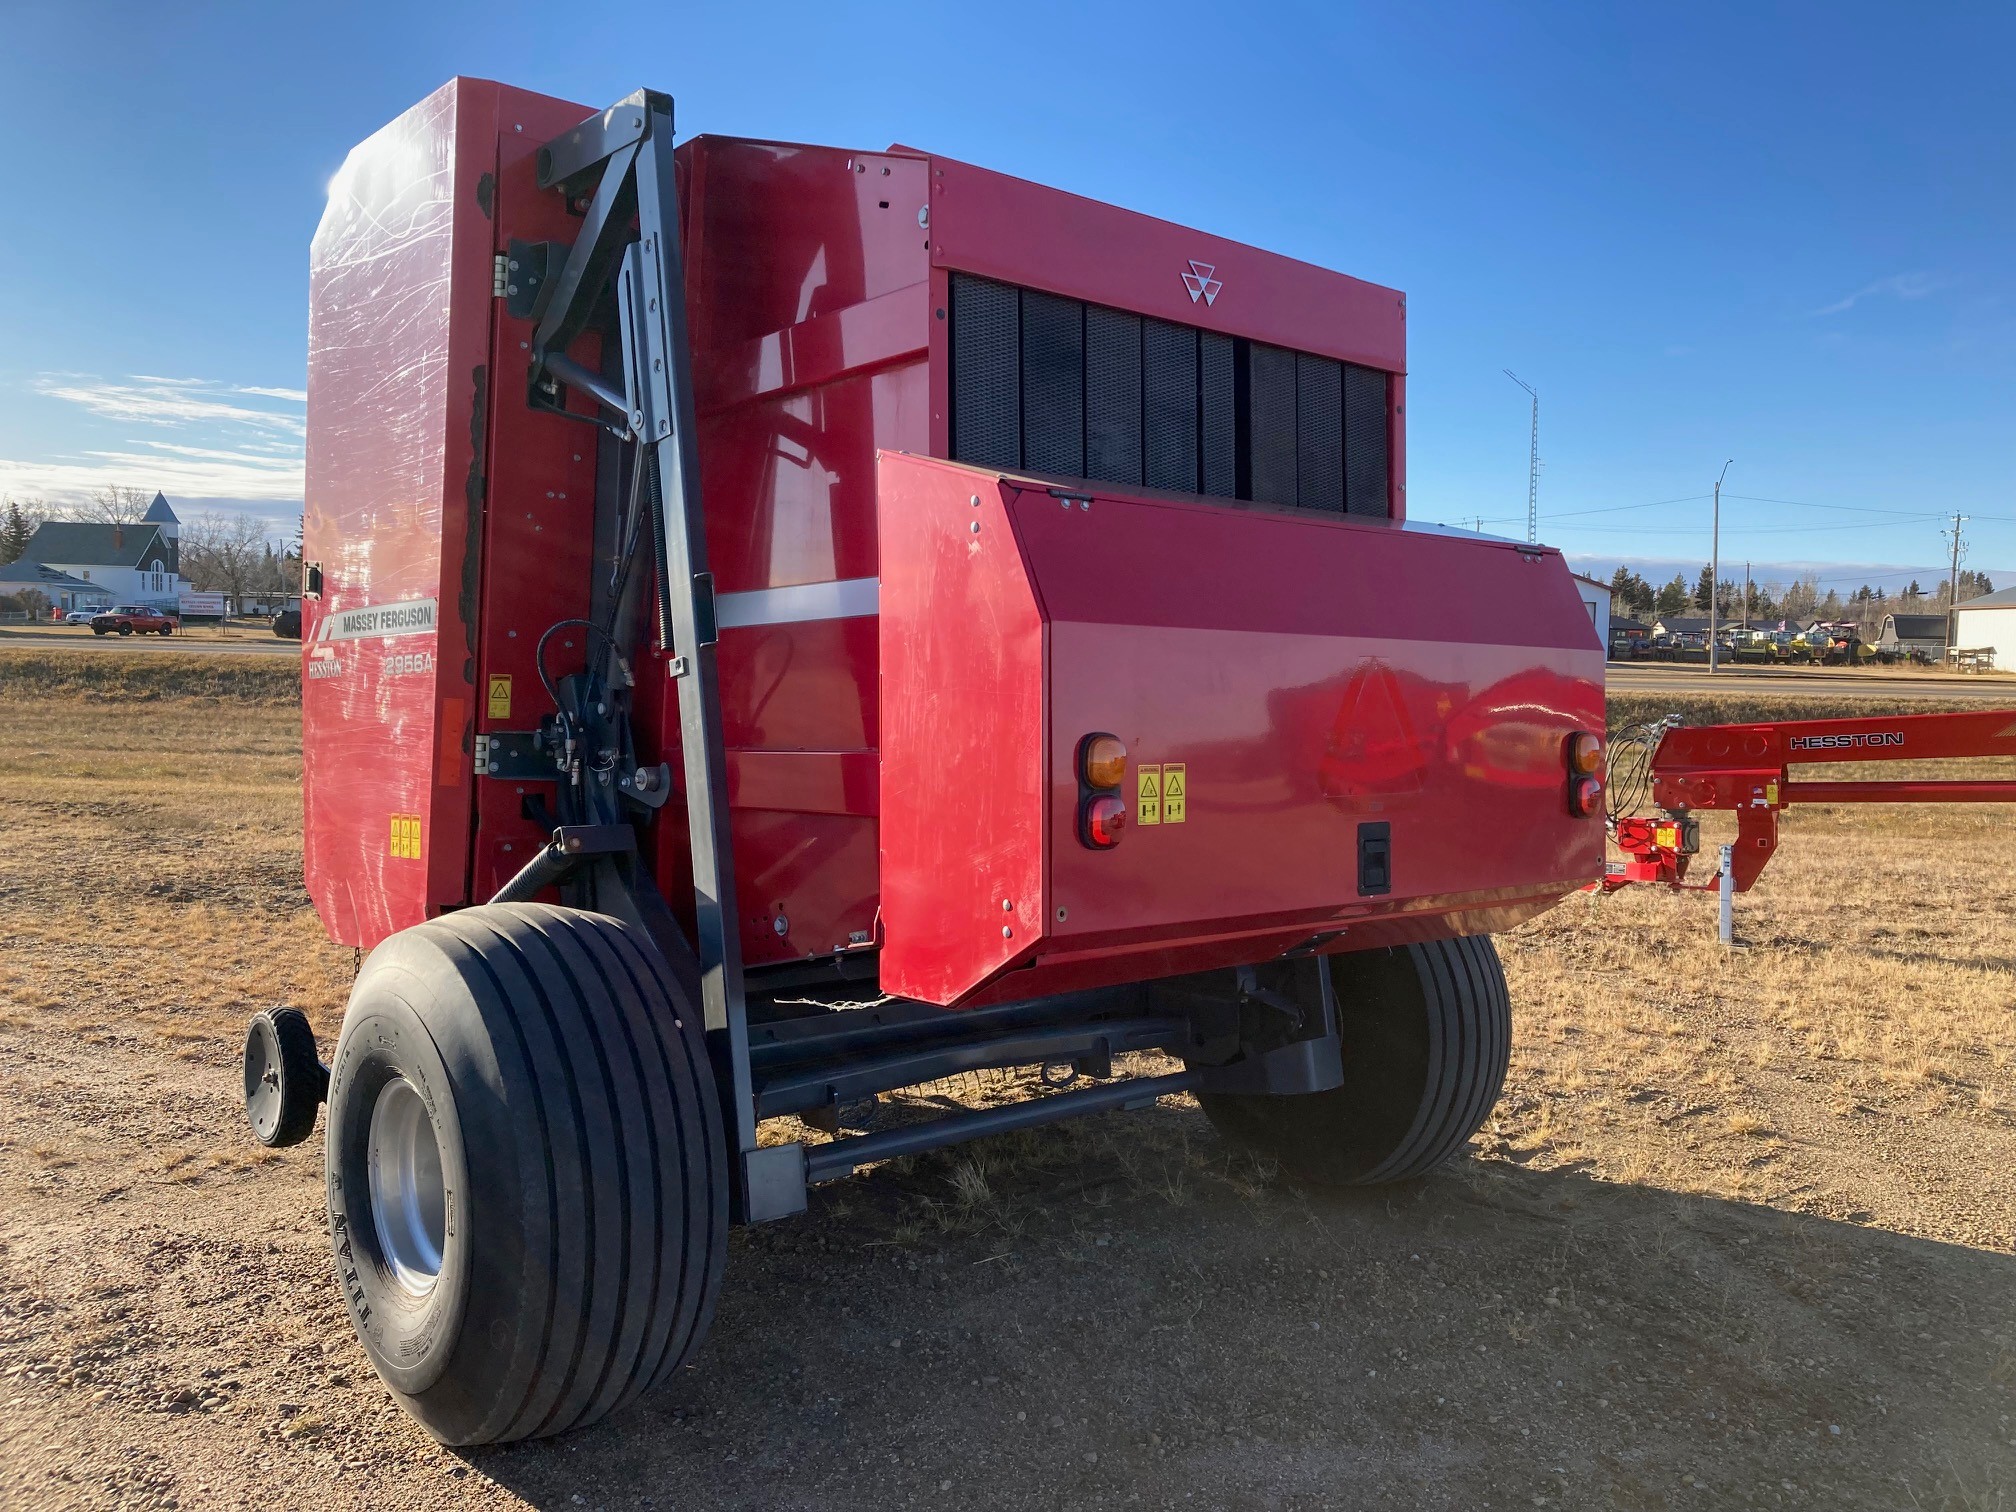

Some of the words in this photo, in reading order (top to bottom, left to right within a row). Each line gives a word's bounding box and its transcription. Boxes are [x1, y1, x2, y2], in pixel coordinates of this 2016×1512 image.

[343, 613, 378, 632] MASSEY
[380, 606, 432, 630] FERGUSON
[385, 653, 433, 675] 2956A
[1790, 732, 1904, 750] HESSTON
[333, 1212, 373, 1329] TITAN
